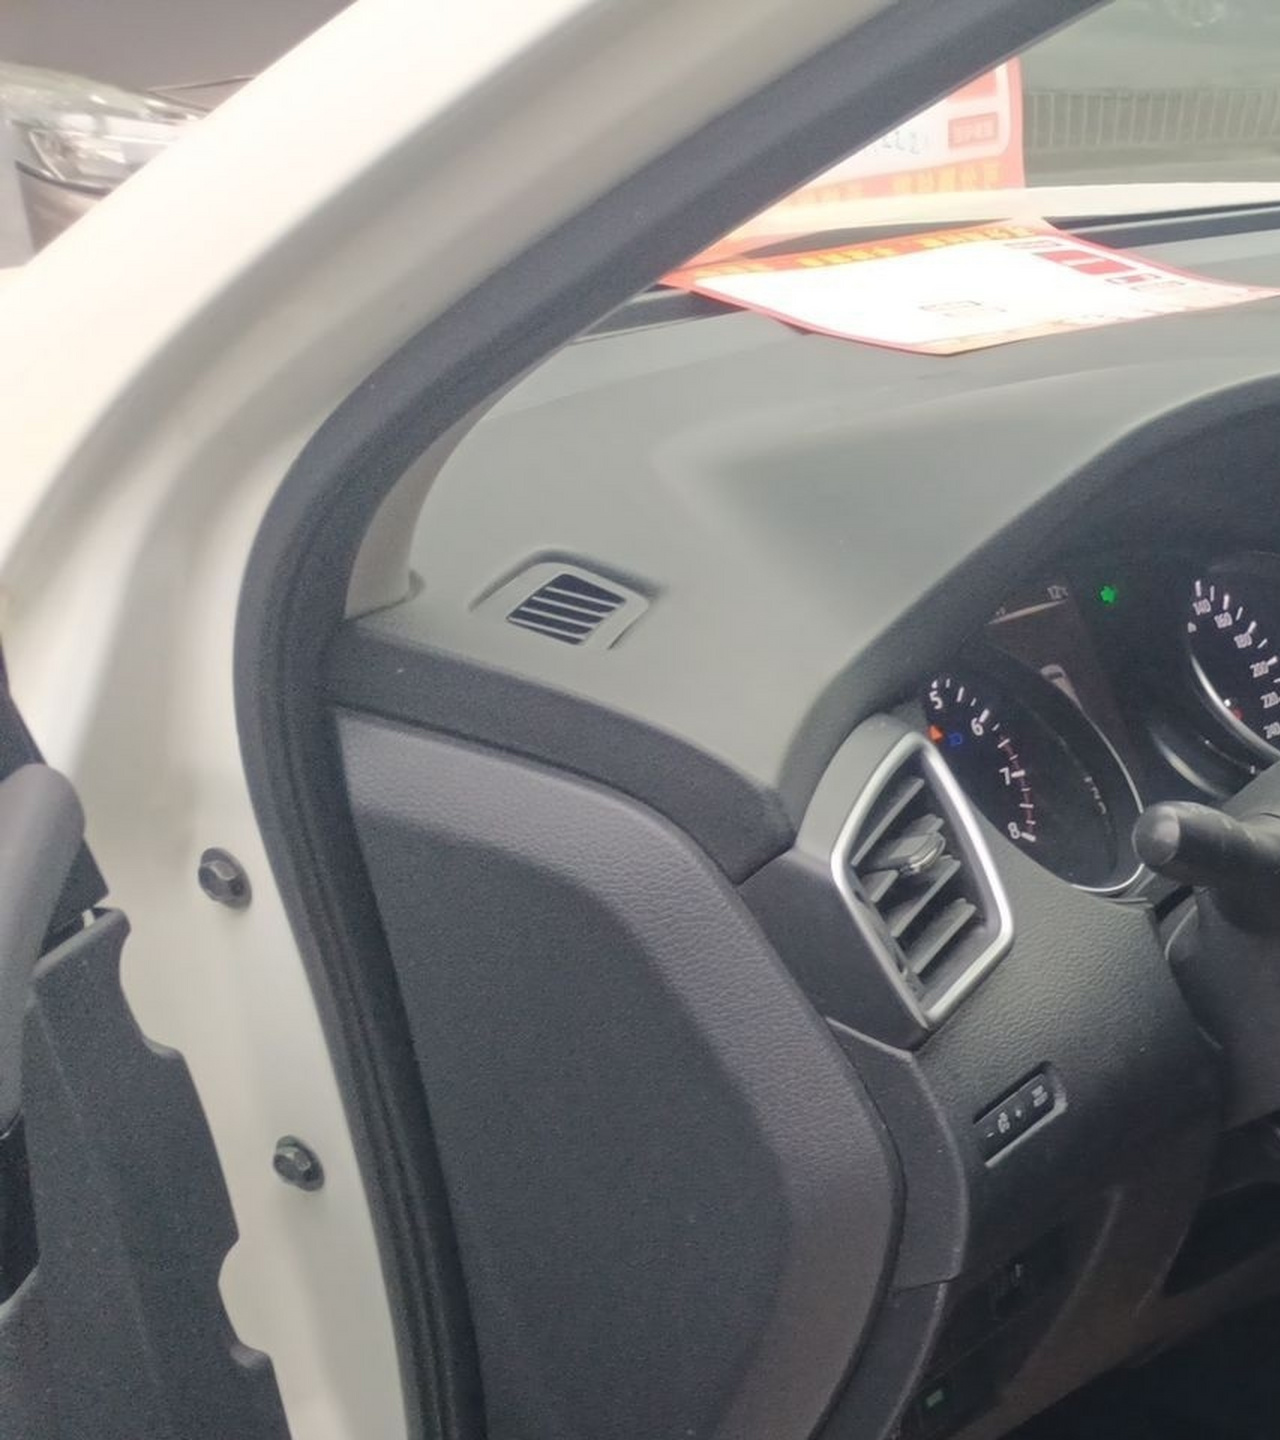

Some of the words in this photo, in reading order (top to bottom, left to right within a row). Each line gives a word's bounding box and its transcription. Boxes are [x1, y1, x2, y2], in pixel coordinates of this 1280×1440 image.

[928, 690, 944, 711] 5
[970, 717, 985, 737] 6
[998, 766, 1012, 786] 7
[1007, 820, 1021, 839] 8
